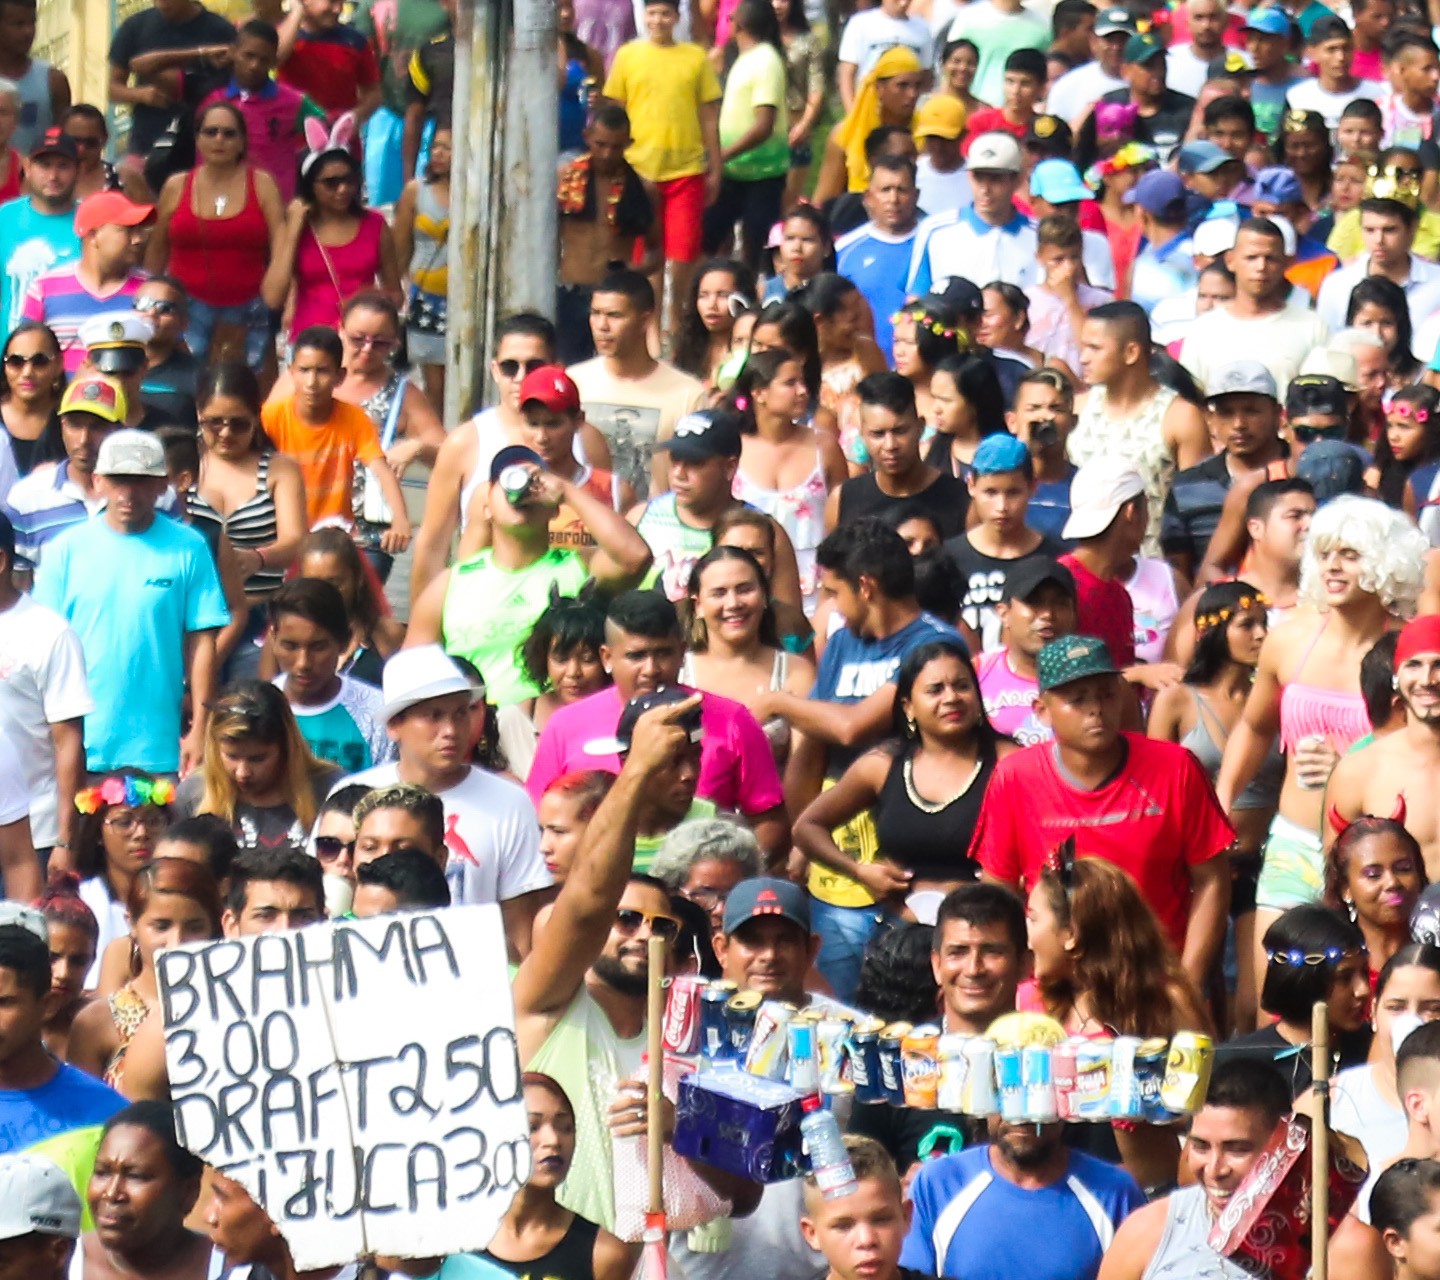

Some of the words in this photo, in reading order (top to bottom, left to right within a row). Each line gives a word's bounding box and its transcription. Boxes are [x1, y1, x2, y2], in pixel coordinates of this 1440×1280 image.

[157, 914, 462, 1028] BRAHMA
[163, 1009, 302, 1091] 3,00
[172, 1057, 395, 1157] DRAFT
[388, 1026, 524, 1122] 2,50
[443, 1125, 534, 1204] 3,00
